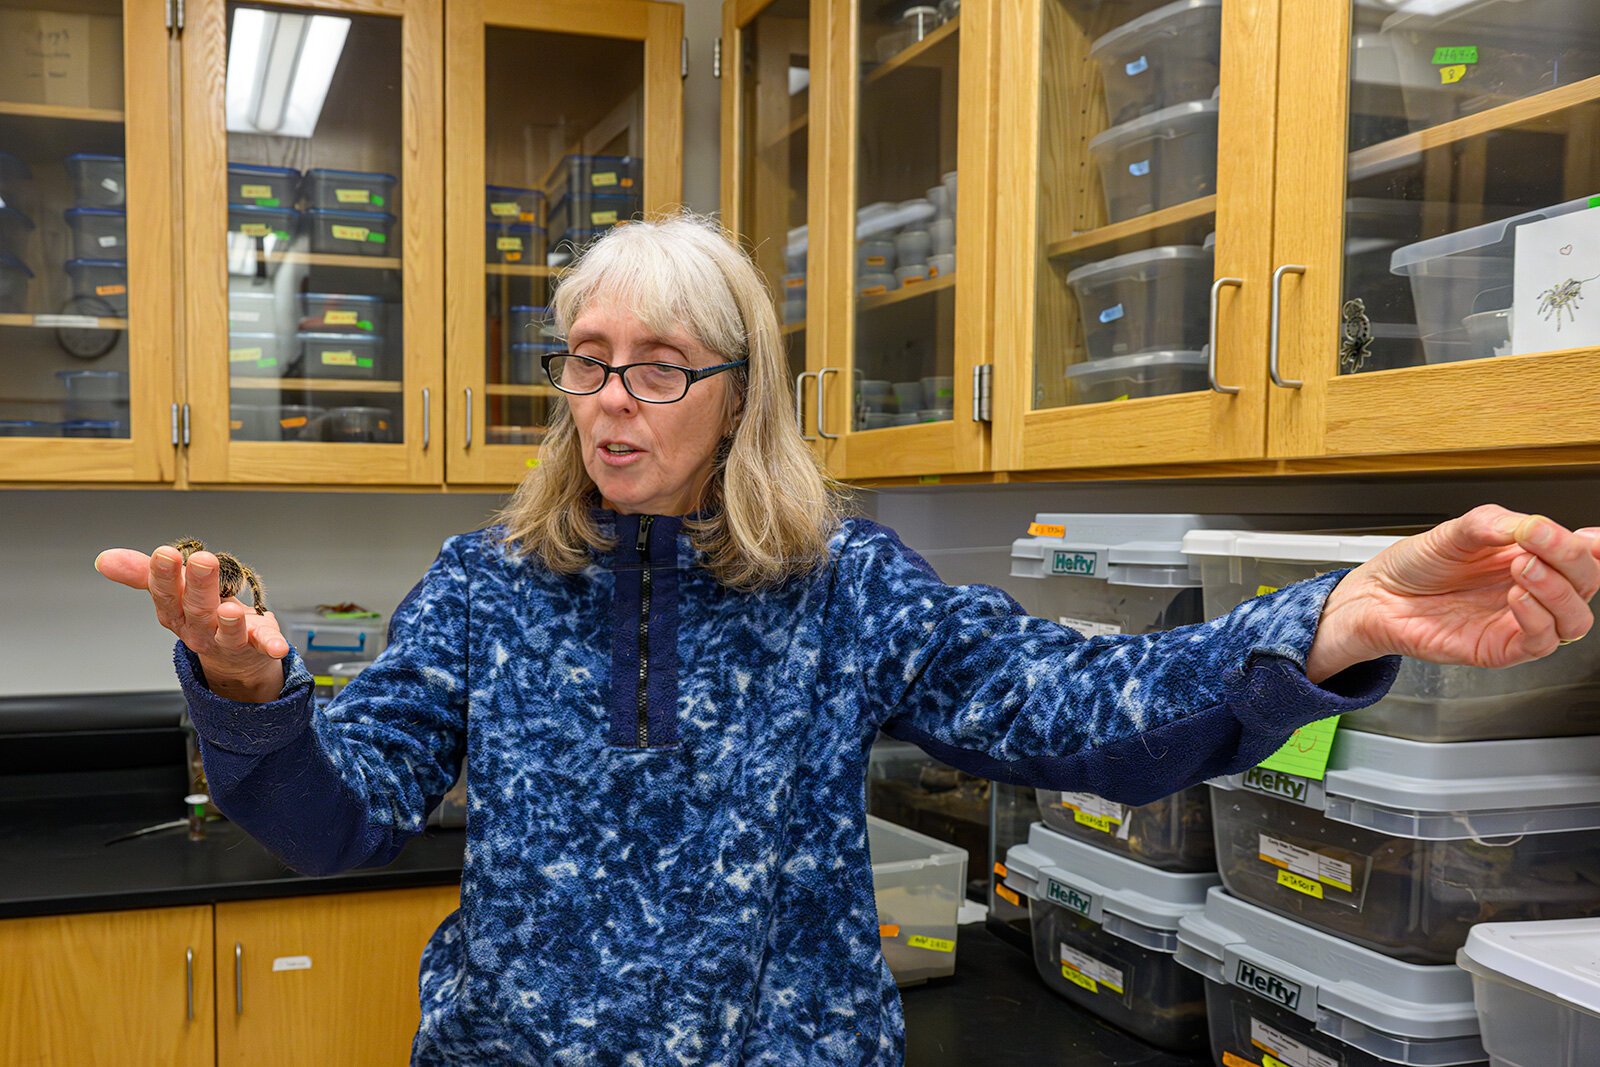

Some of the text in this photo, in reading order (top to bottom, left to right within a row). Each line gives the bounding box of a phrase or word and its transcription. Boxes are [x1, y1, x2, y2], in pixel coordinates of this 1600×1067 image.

[1055, 553, 1094, 574] Hefty
[1247, 768, 1304, 799] Hefty
[1050, 882, 1090, 914] Hefty
[1240, 964, 1297, 1006] Hefty
